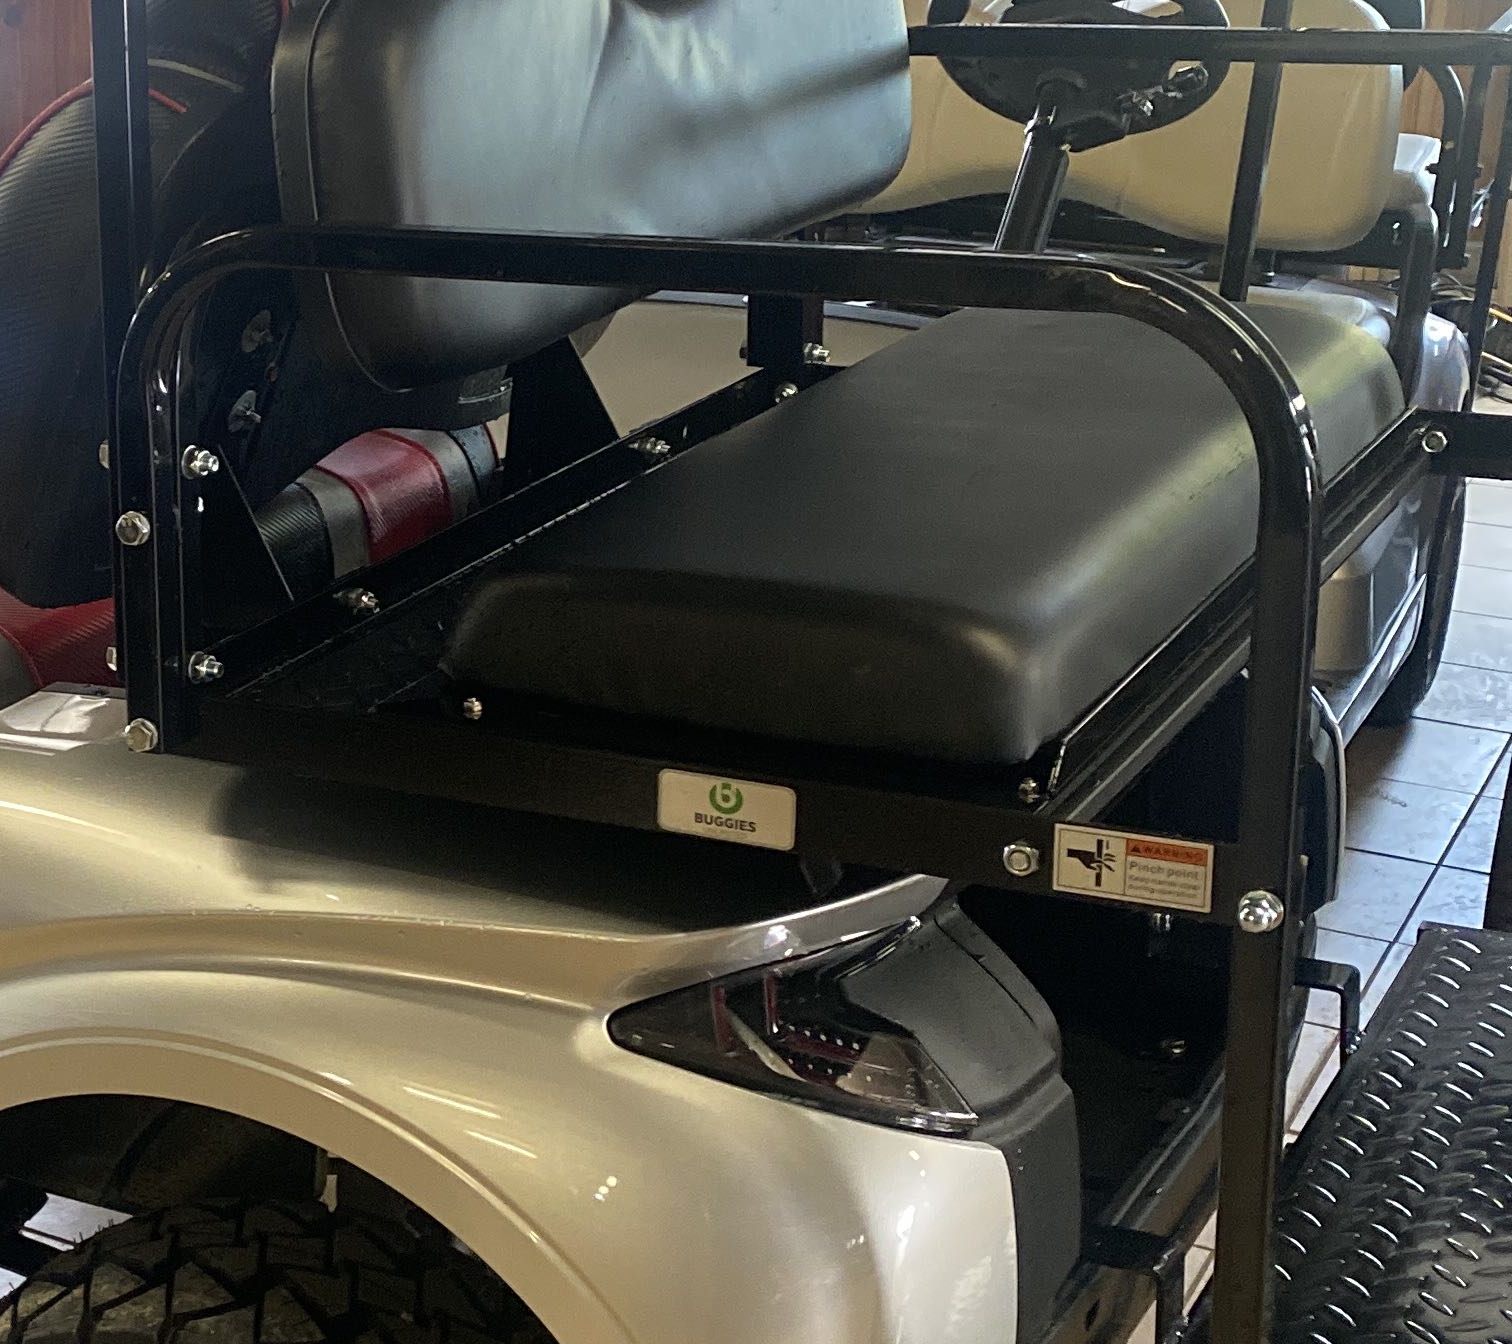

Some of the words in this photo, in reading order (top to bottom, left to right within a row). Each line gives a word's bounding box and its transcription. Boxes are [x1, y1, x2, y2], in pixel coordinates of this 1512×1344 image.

[694, 811, 757, 833] BUGGIES
[1129, 860, 1166, 875] Pinch
[1167, 866, 1199, 880] point
